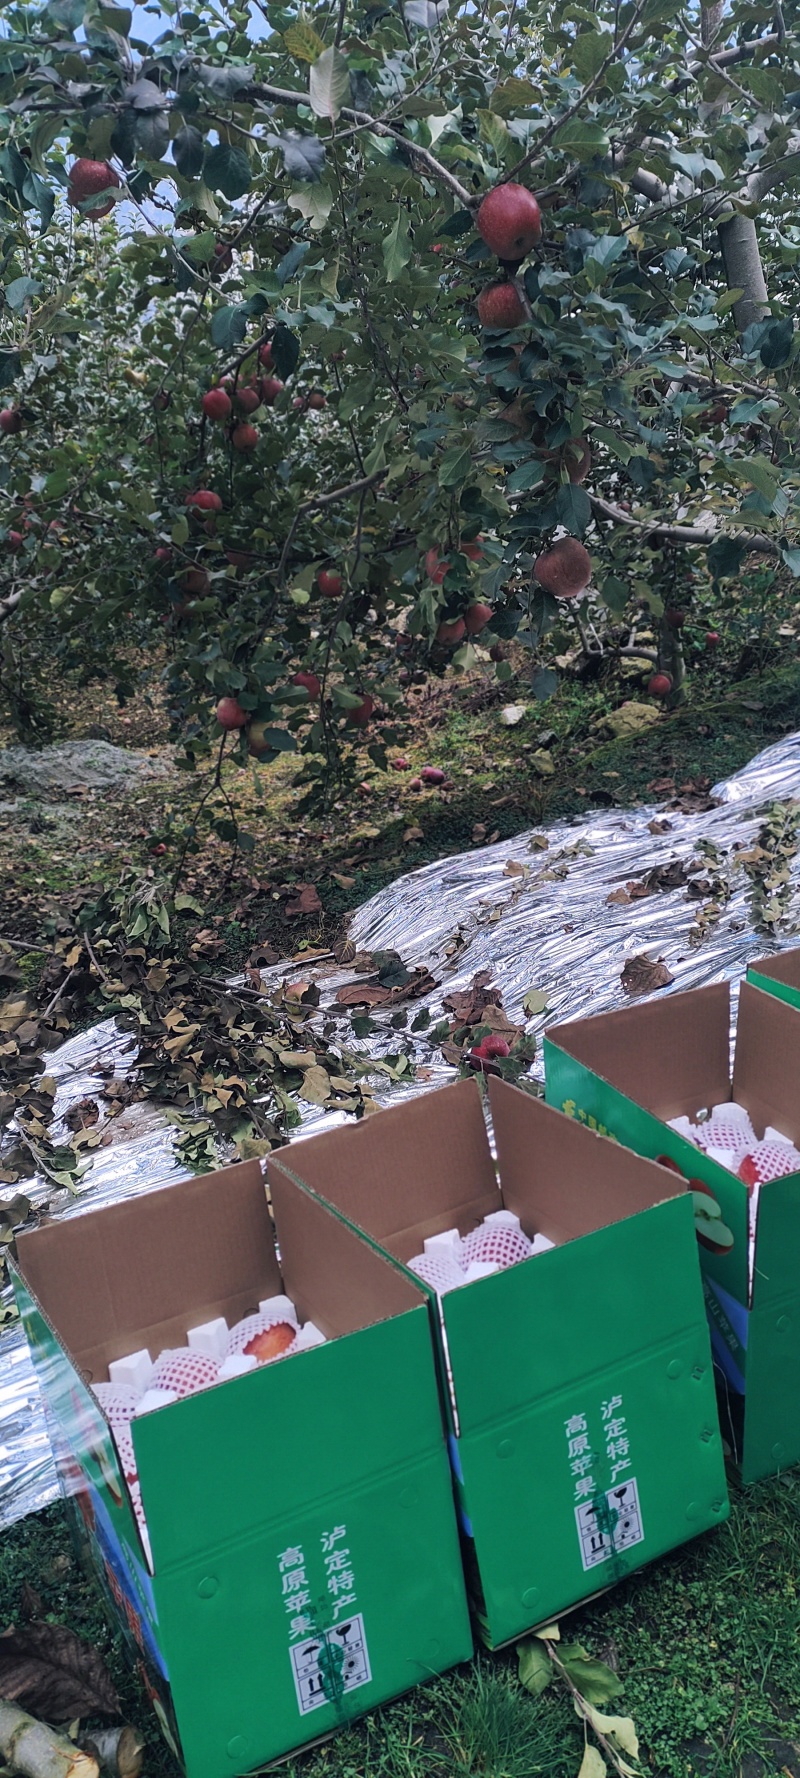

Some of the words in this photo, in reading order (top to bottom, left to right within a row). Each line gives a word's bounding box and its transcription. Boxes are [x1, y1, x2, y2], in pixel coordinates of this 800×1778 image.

[563, 1412, 597, 1501] 高原苹果
[600, 1394, 632, 1484] 泸定特产
[276, 1544, 317, 1641] 高原苹果
[320, 1524, 358, 1620] 泸定特产
